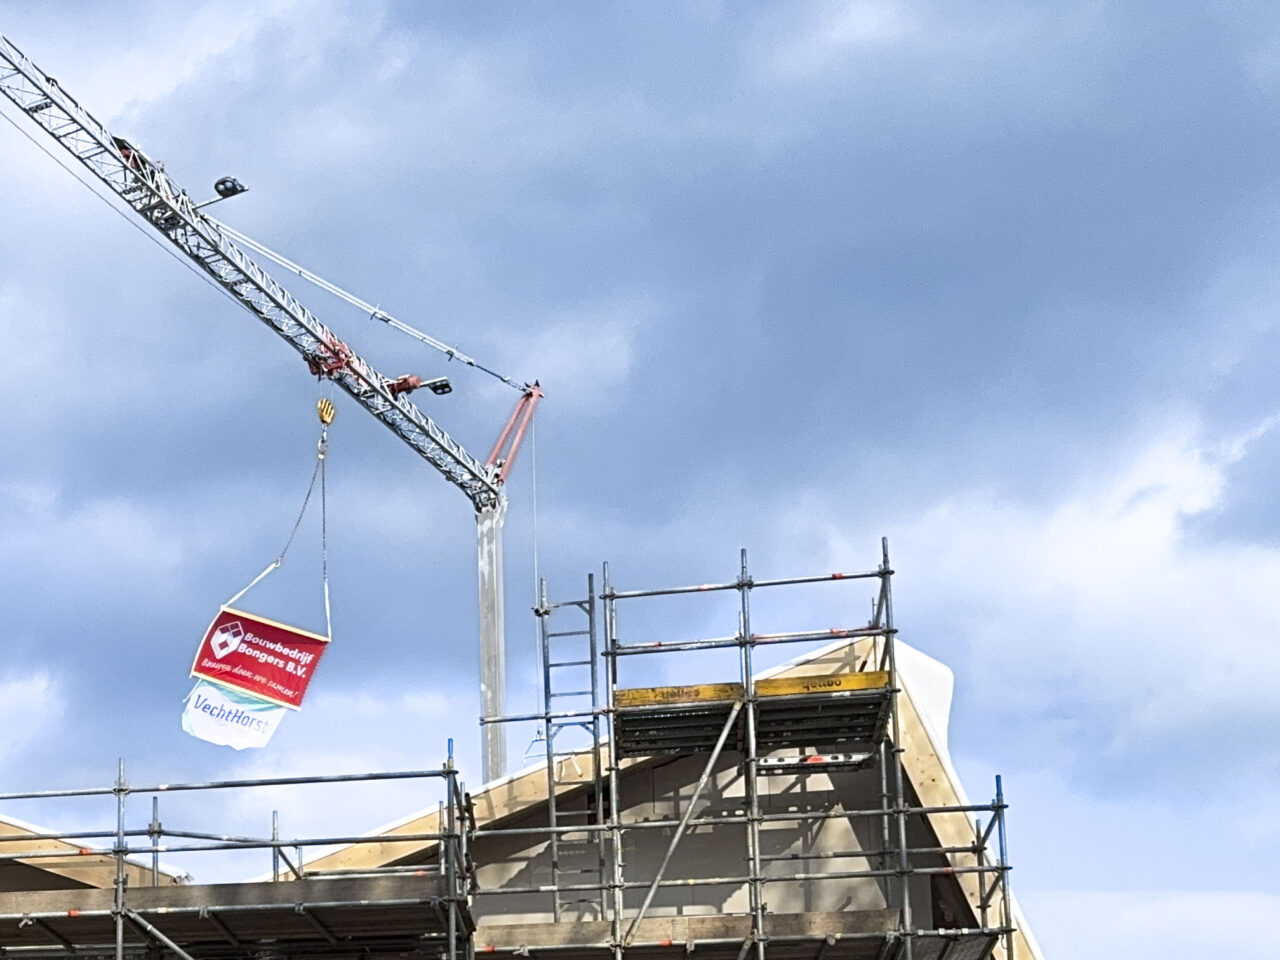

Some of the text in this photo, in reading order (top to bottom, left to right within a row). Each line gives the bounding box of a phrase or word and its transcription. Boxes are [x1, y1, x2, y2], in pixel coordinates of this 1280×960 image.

[237, 643, 306, 678] Bongers B.V.
[244, 632, 314, 665] Bouwbedrijf
[232, 665, 254, 678] doen
[193, 693, 270, 734] VechtHorst
